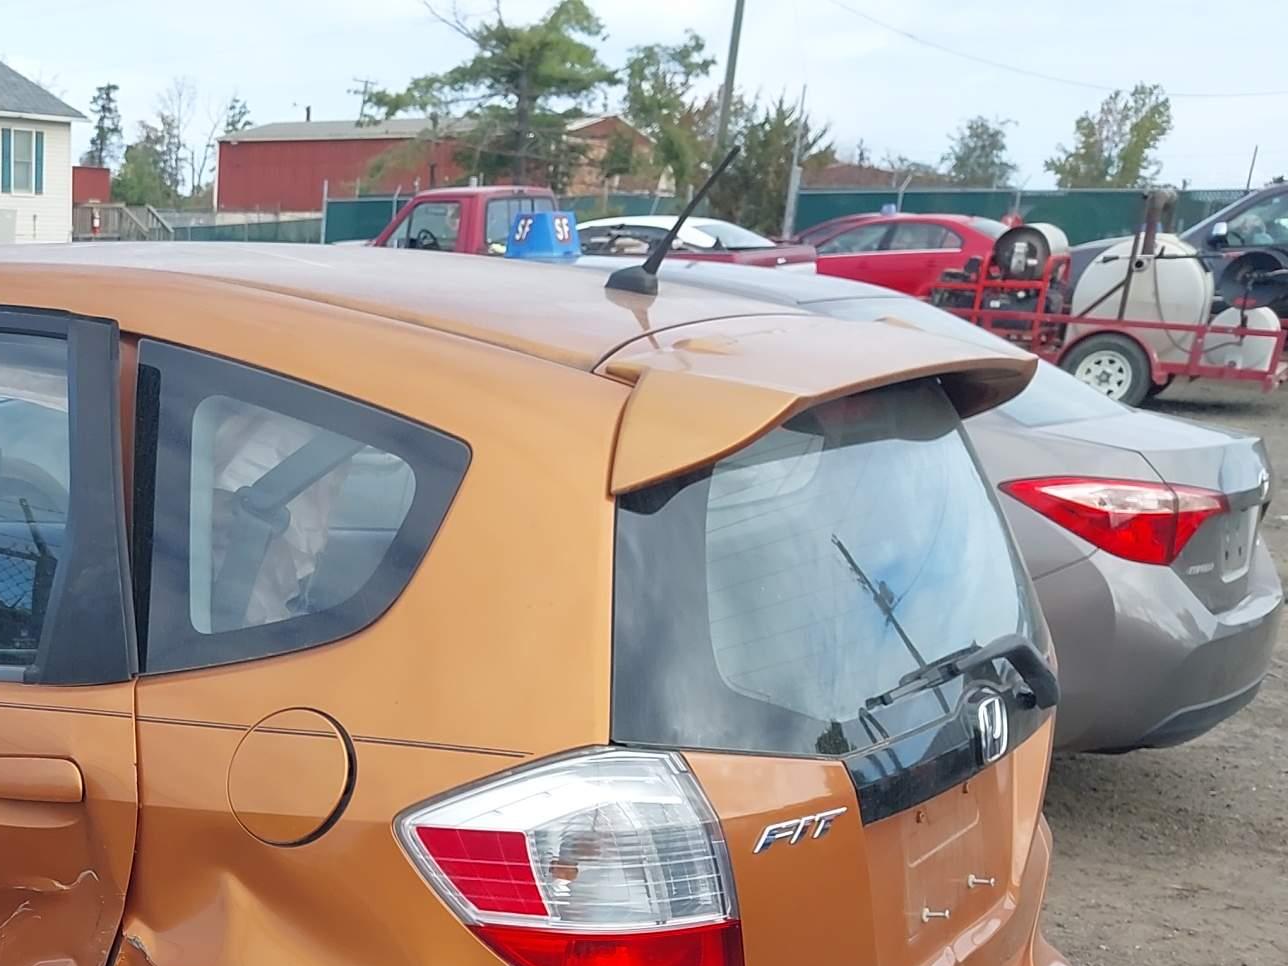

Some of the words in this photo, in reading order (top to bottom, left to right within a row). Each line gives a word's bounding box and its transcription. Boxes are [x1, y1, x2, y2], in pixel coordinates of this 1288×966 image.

[514, 218, 534, 241] SF
[554, 217, 571, 242] SF
[752, 806, 848, 854] FIT
